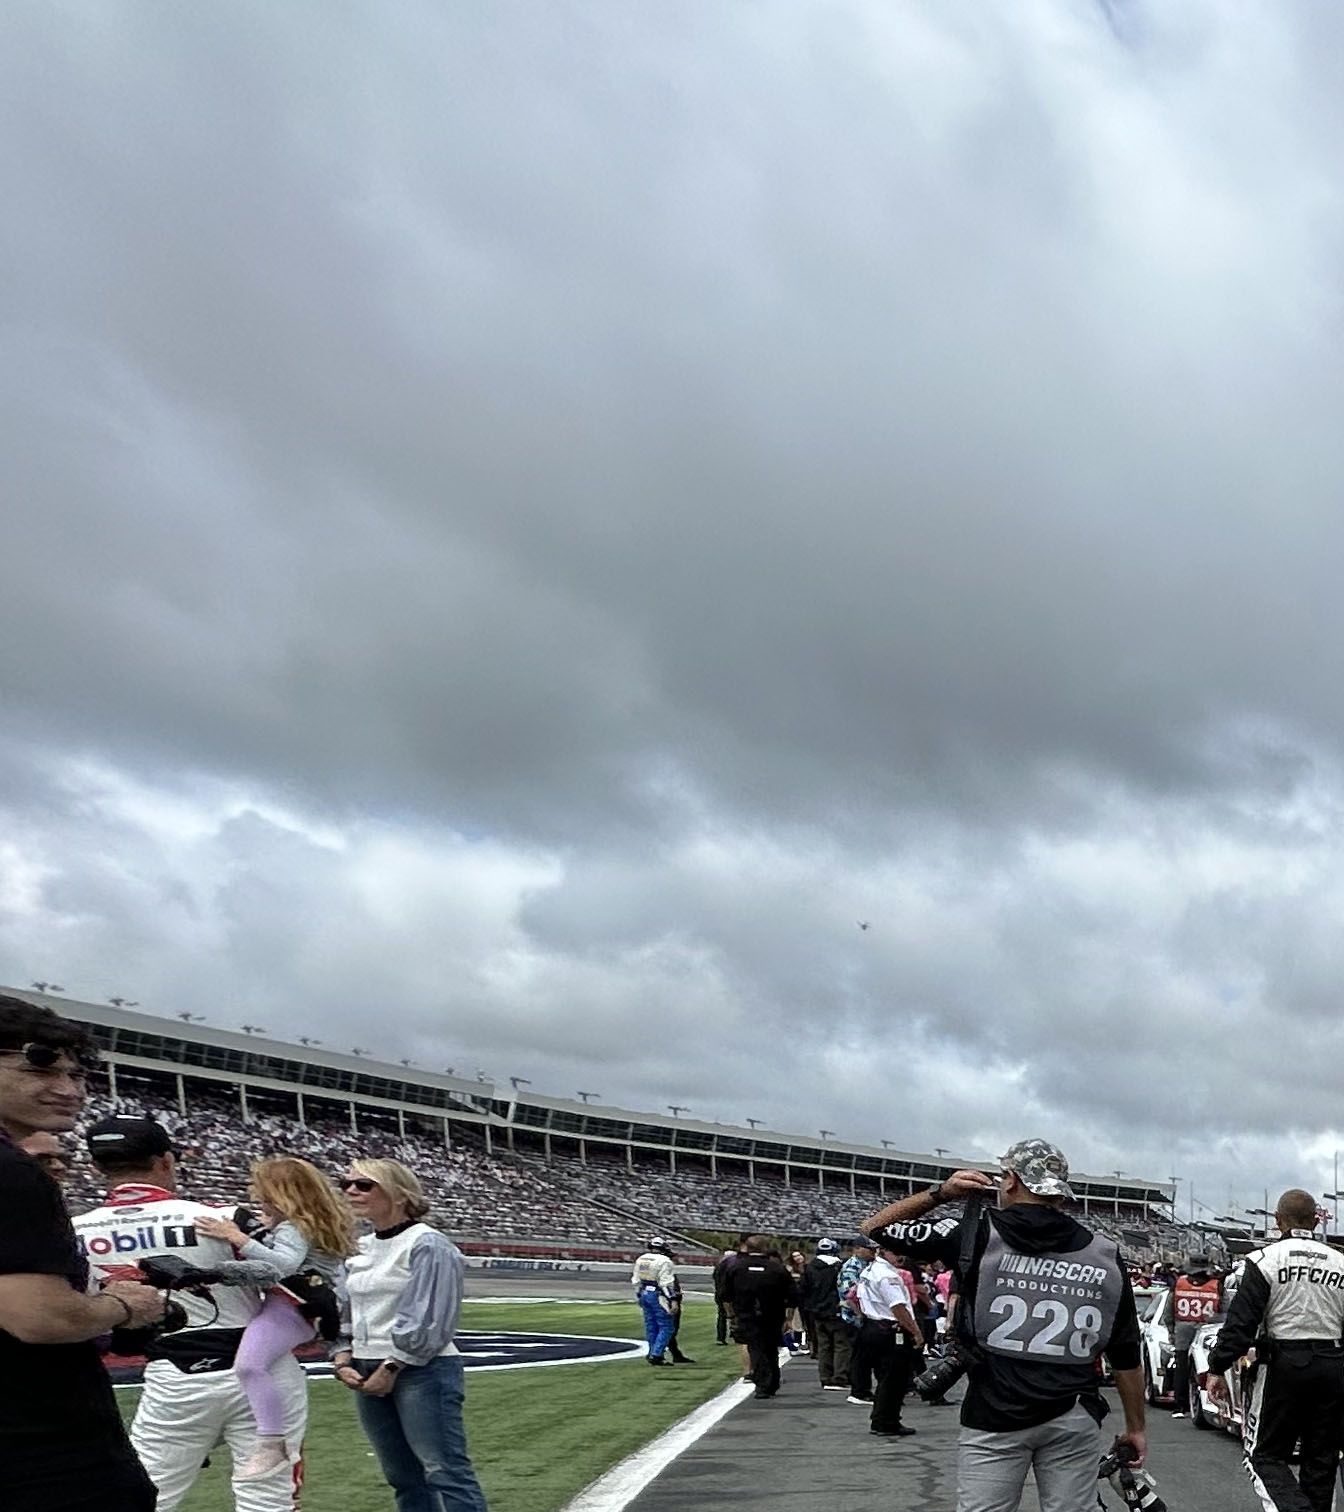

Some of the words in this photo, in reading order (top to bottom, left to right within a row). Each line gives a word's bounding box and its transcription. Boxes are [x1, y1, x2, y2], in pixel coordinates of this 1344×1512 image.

[1022, 1255, 1107, 1286] NASCAR
[996, 1277, 1103, 1300] PRODUCTIONS
[1177, 1298, 1215, 1318] 934
[986, 1295, 1103, 1358] 228
